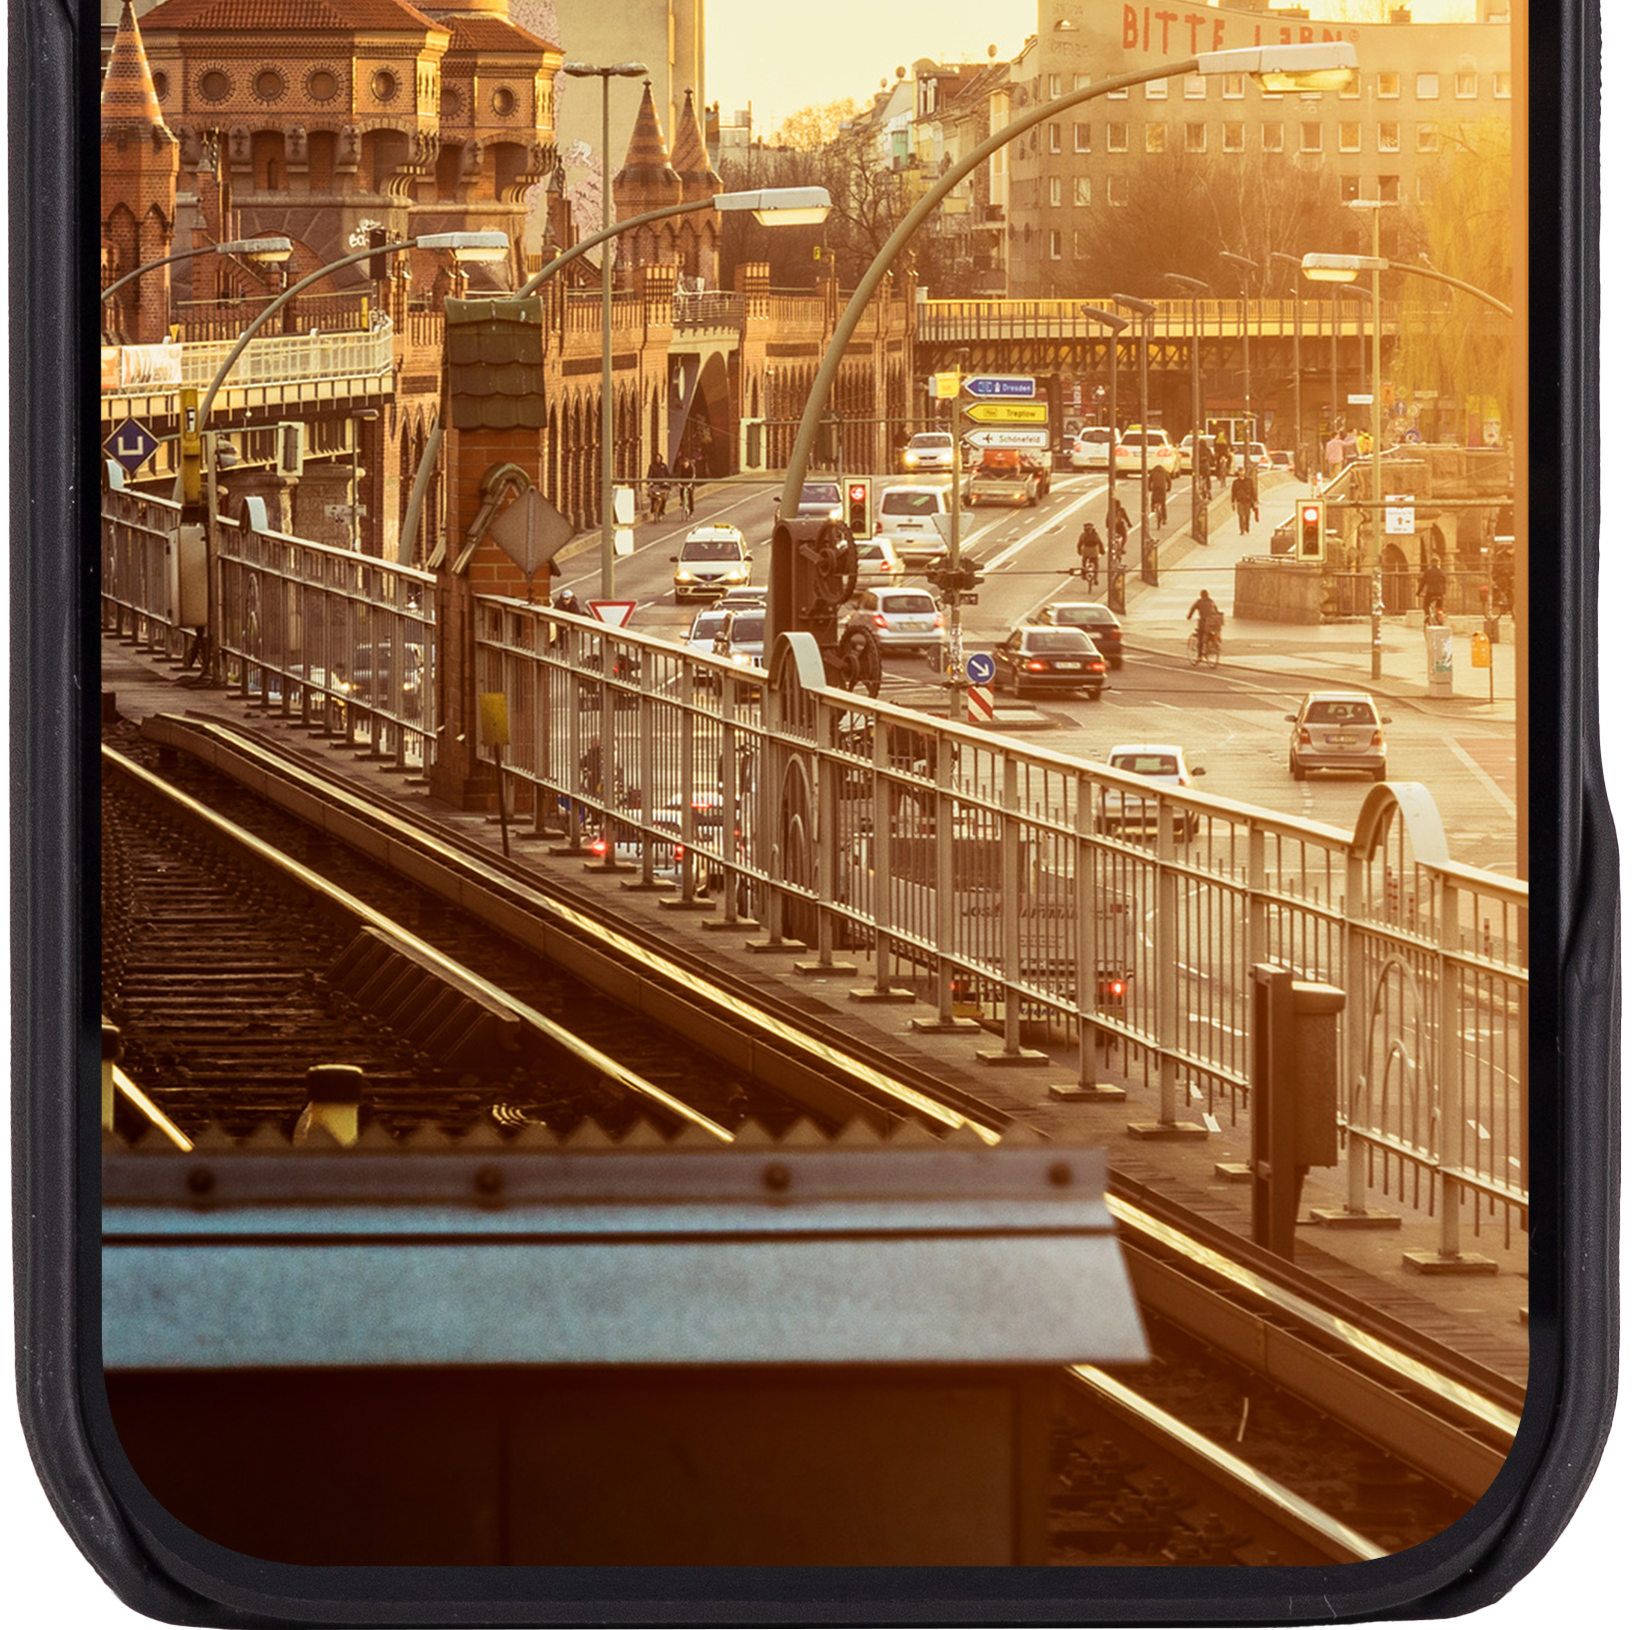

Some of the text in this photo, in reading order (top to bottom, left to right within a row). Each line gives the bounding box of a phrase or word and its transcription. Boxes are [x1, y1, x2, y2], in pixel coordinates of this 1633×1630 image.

[1123, 4, 1225, 55] BITTE
[1002, 383, 1031, 392] Dresden
[186, 409, 195, 432] F
[1006, 409, 1036, 419] Treptow
[117, 436, 144, 456] U
[999, 434, 1040, 443] Schönefeld
